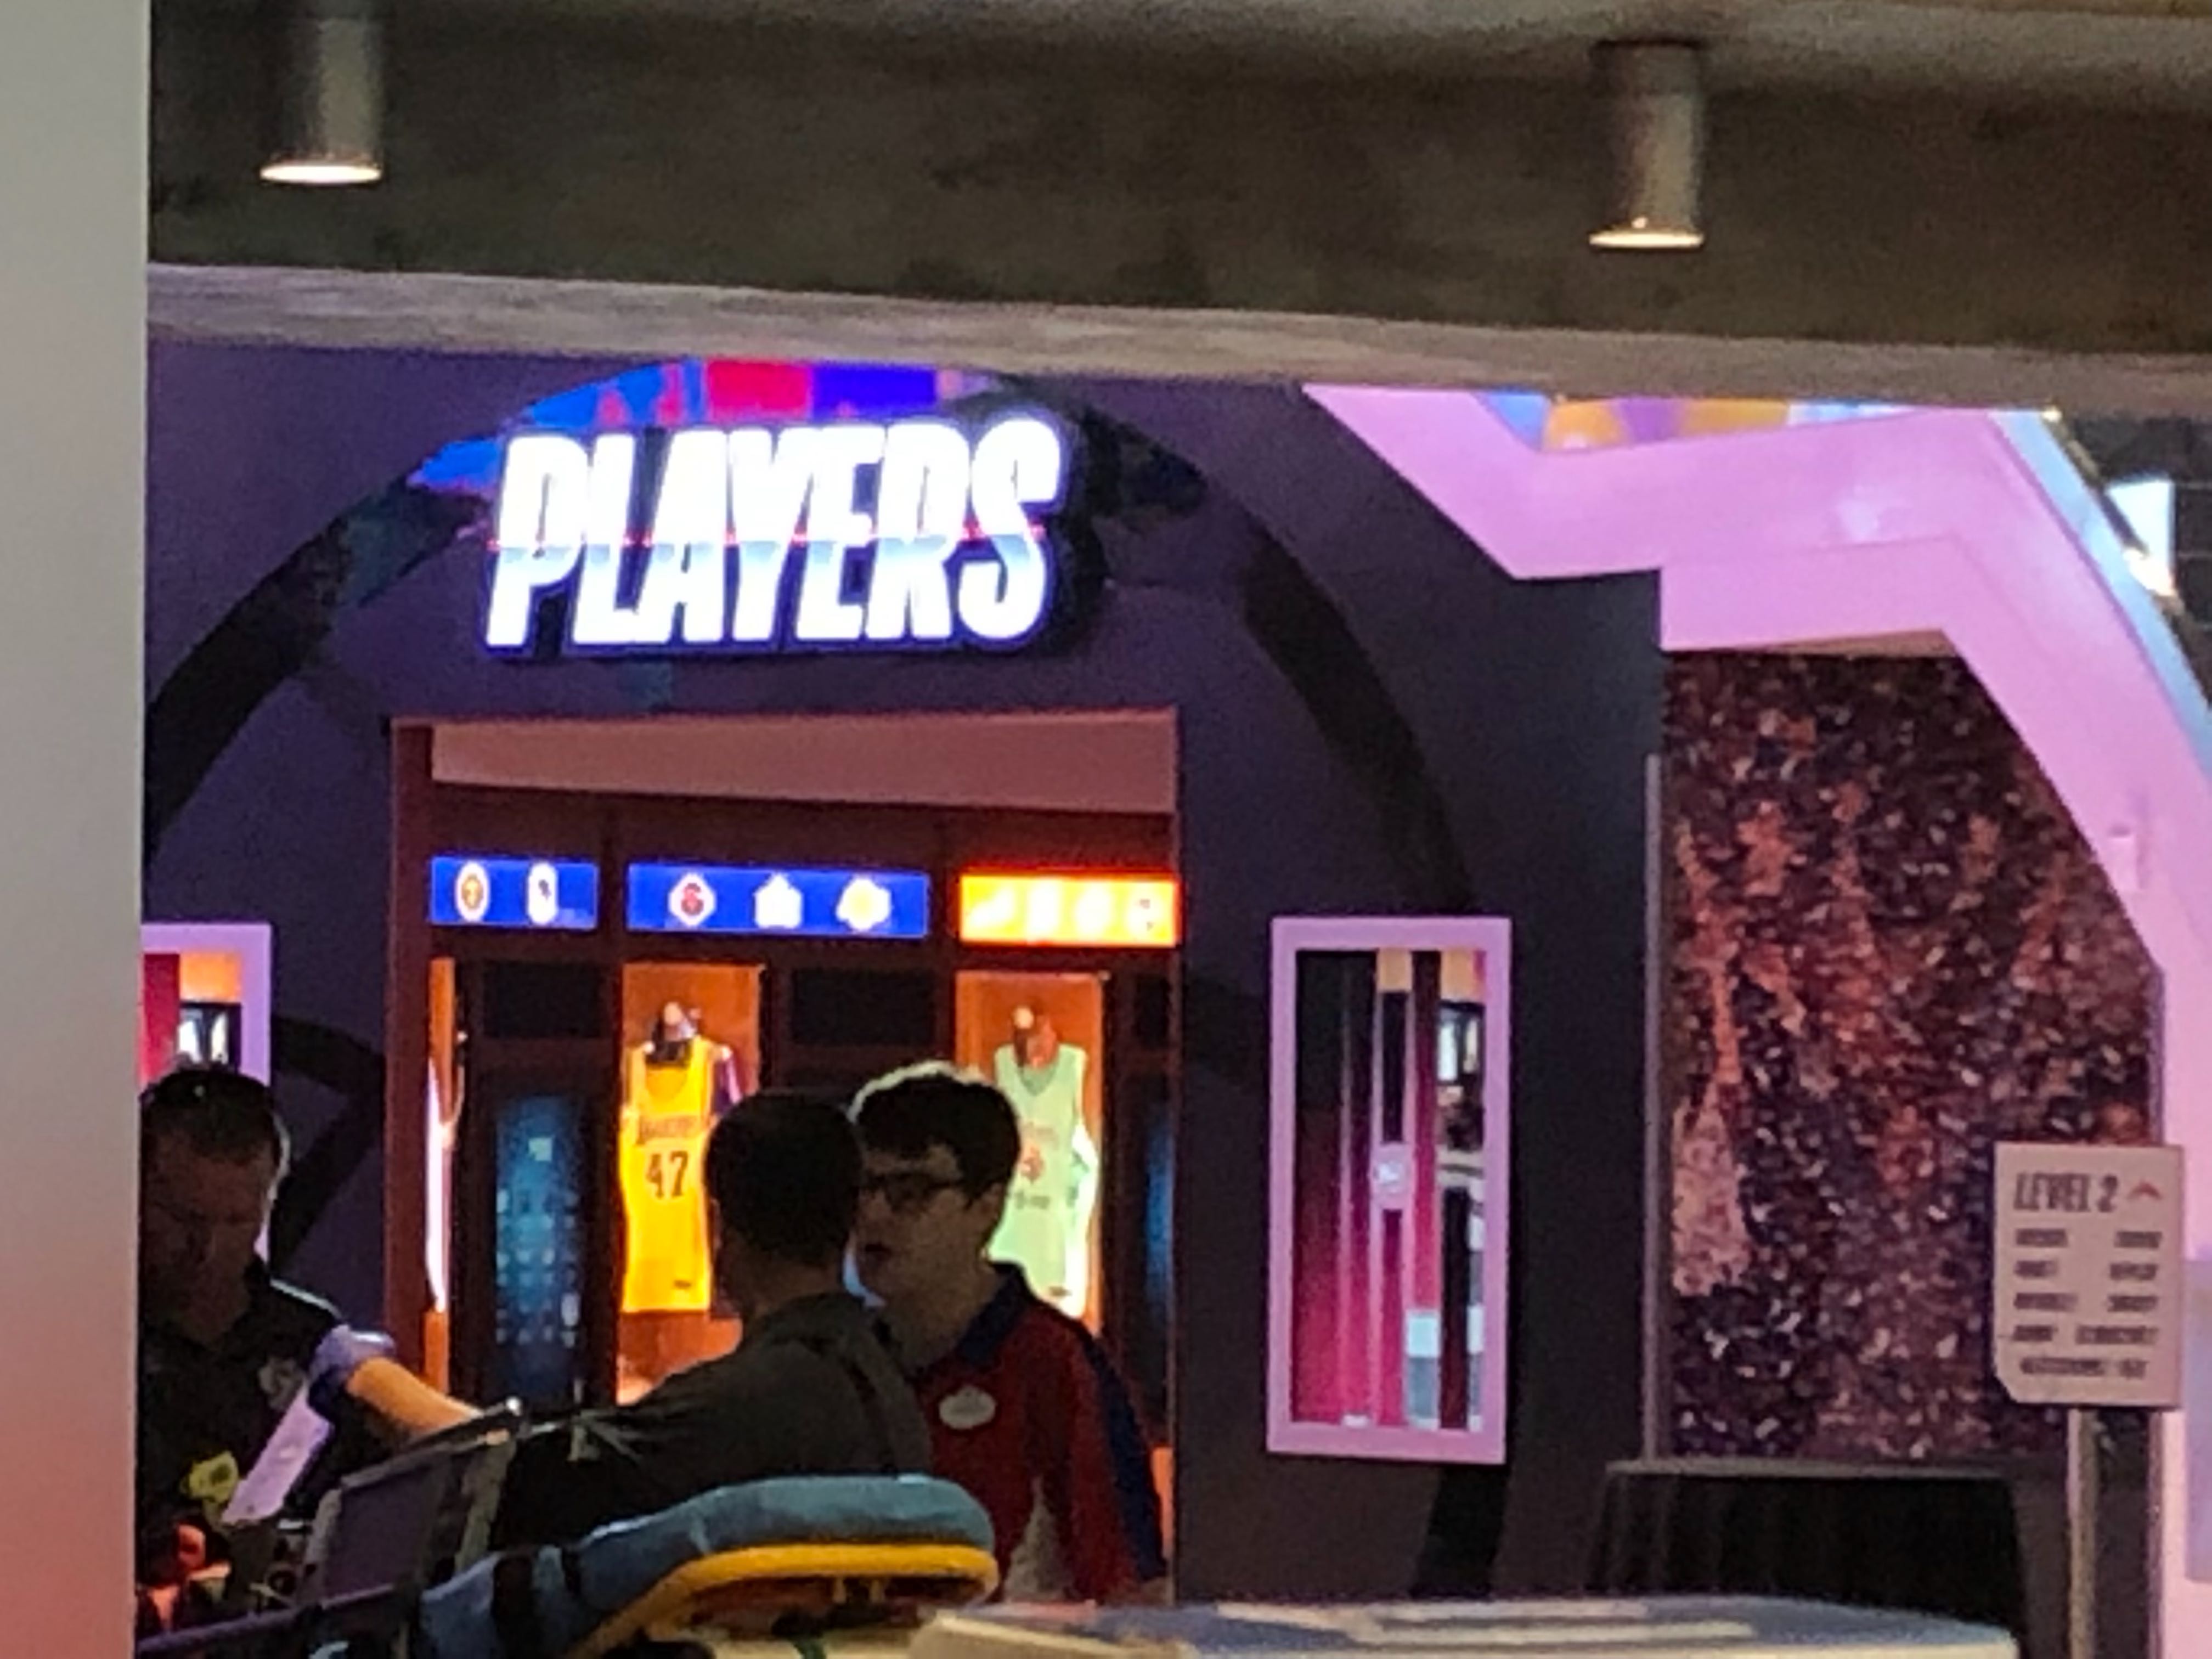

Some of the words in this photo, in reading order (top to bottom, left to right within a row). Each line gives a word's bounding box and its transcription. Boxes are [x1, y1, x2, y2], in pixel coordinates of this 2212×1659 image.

[486, 417, 1063, 647] PLAYERS
[645, 1150, 689, 1199] 47
[2013, 1172, 2091, 1212] LEVEL
[2097, 1174, 2119, 1213] 2
